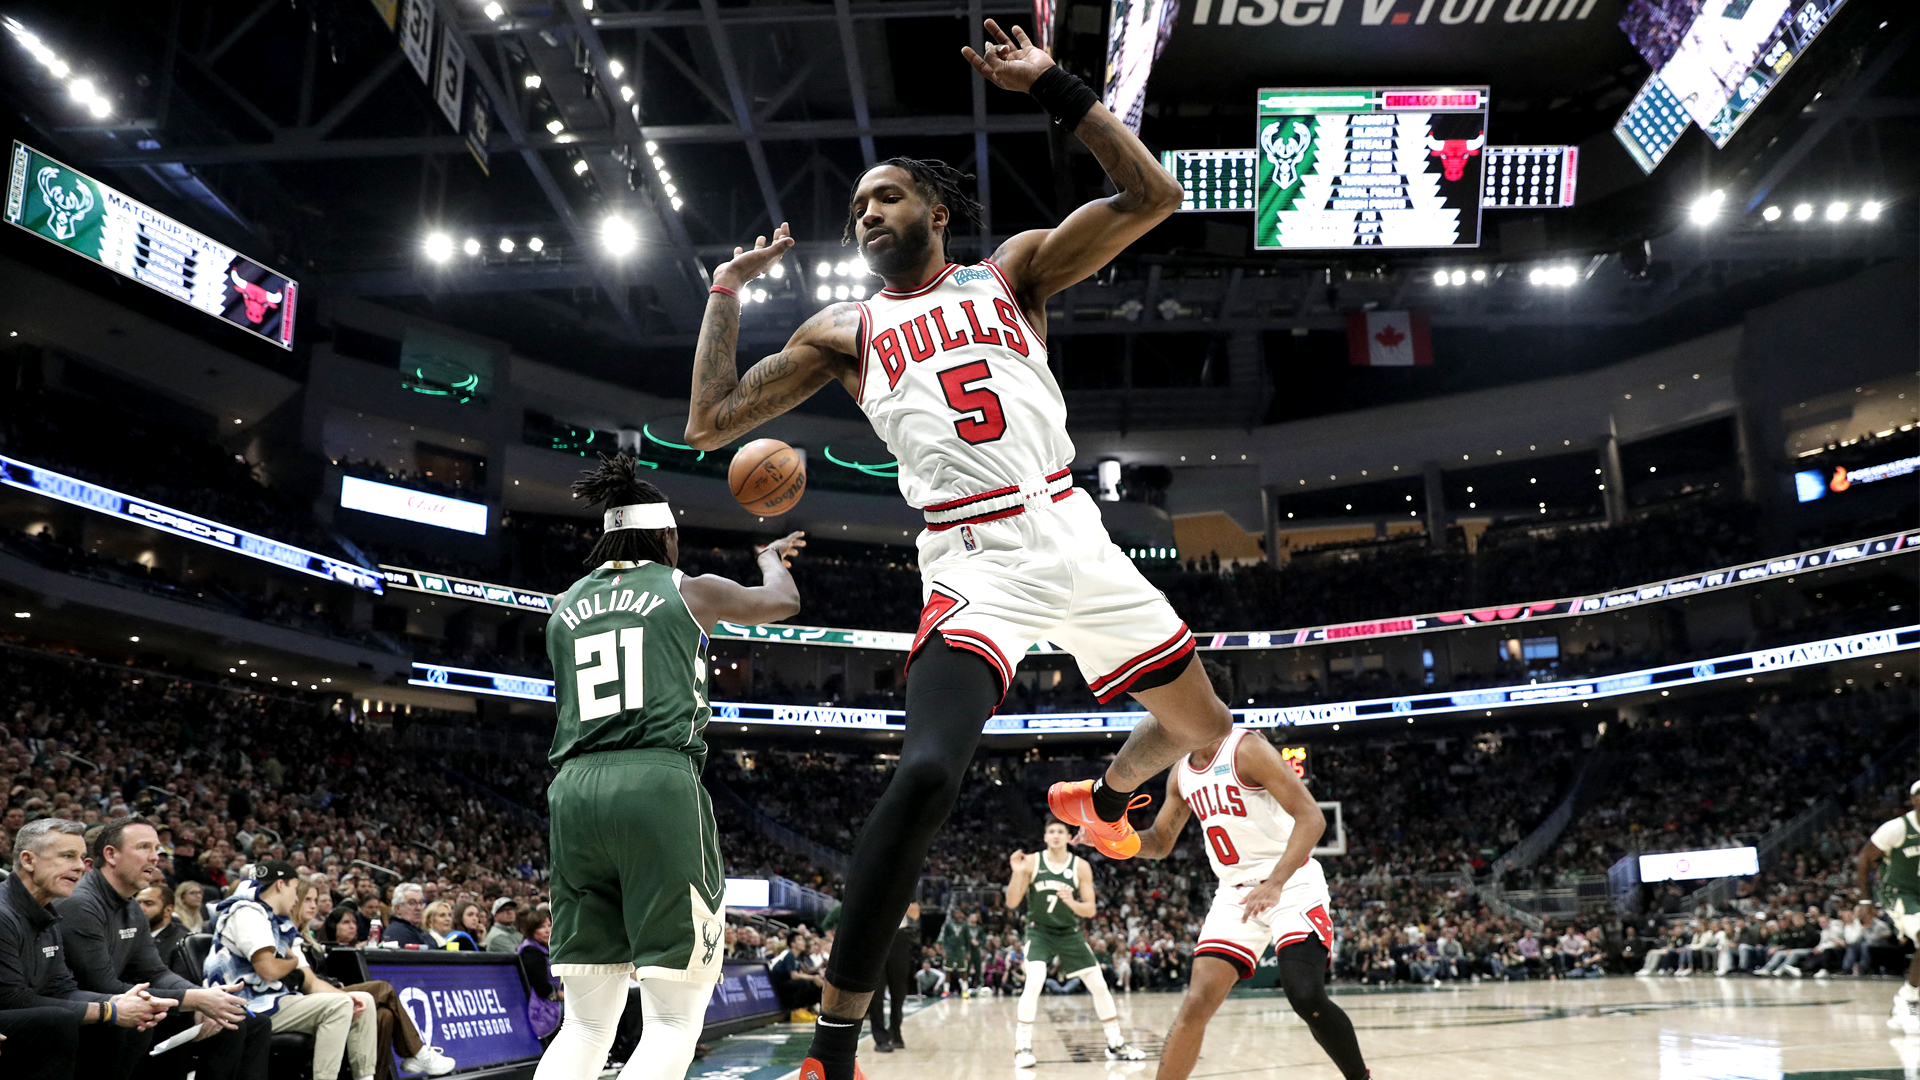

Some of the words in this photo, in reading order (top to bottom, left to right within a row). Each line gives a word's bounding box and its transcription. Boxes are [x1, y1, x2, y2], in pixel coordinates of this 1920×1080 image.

[1796, 2, 1822, 31] 22
[1385, 95, 1437, 107] CHICAGO
[1441, 95, 1477, 106] BULLS
[1738, 76, 1759, 101] 49
[108, 193, 182, 235] MATCHUP
[185, 232, 227, 260] STATS
[871, 297, 1030, 392] BULLS
[936, 359, 1008, 446] 5
[128, 503, 235, 545] PORSCHE
[240, 535, 312, 569] GIVEAWAY
[559, 589, 666, 631] HOLIDAY
[1326, 623, 1376, 640] CHICAGO
[1379, 619, 1413, 636] BULLS
[574, 626, 644, 722] 21
[1244, 705, 1357, 726] POTAWATOMI
[1756, 634, 1896, 668] POTAWATOMI
[774, 709, 887, 735] POTAWATOMI
[1206, 825, 1240, 866] 0
[1046, 894, 1059, 914] 7
[431, 988, 506, 1018] FANDUEL
[440, 1017, 513, 1041] SPORTSBOOK
